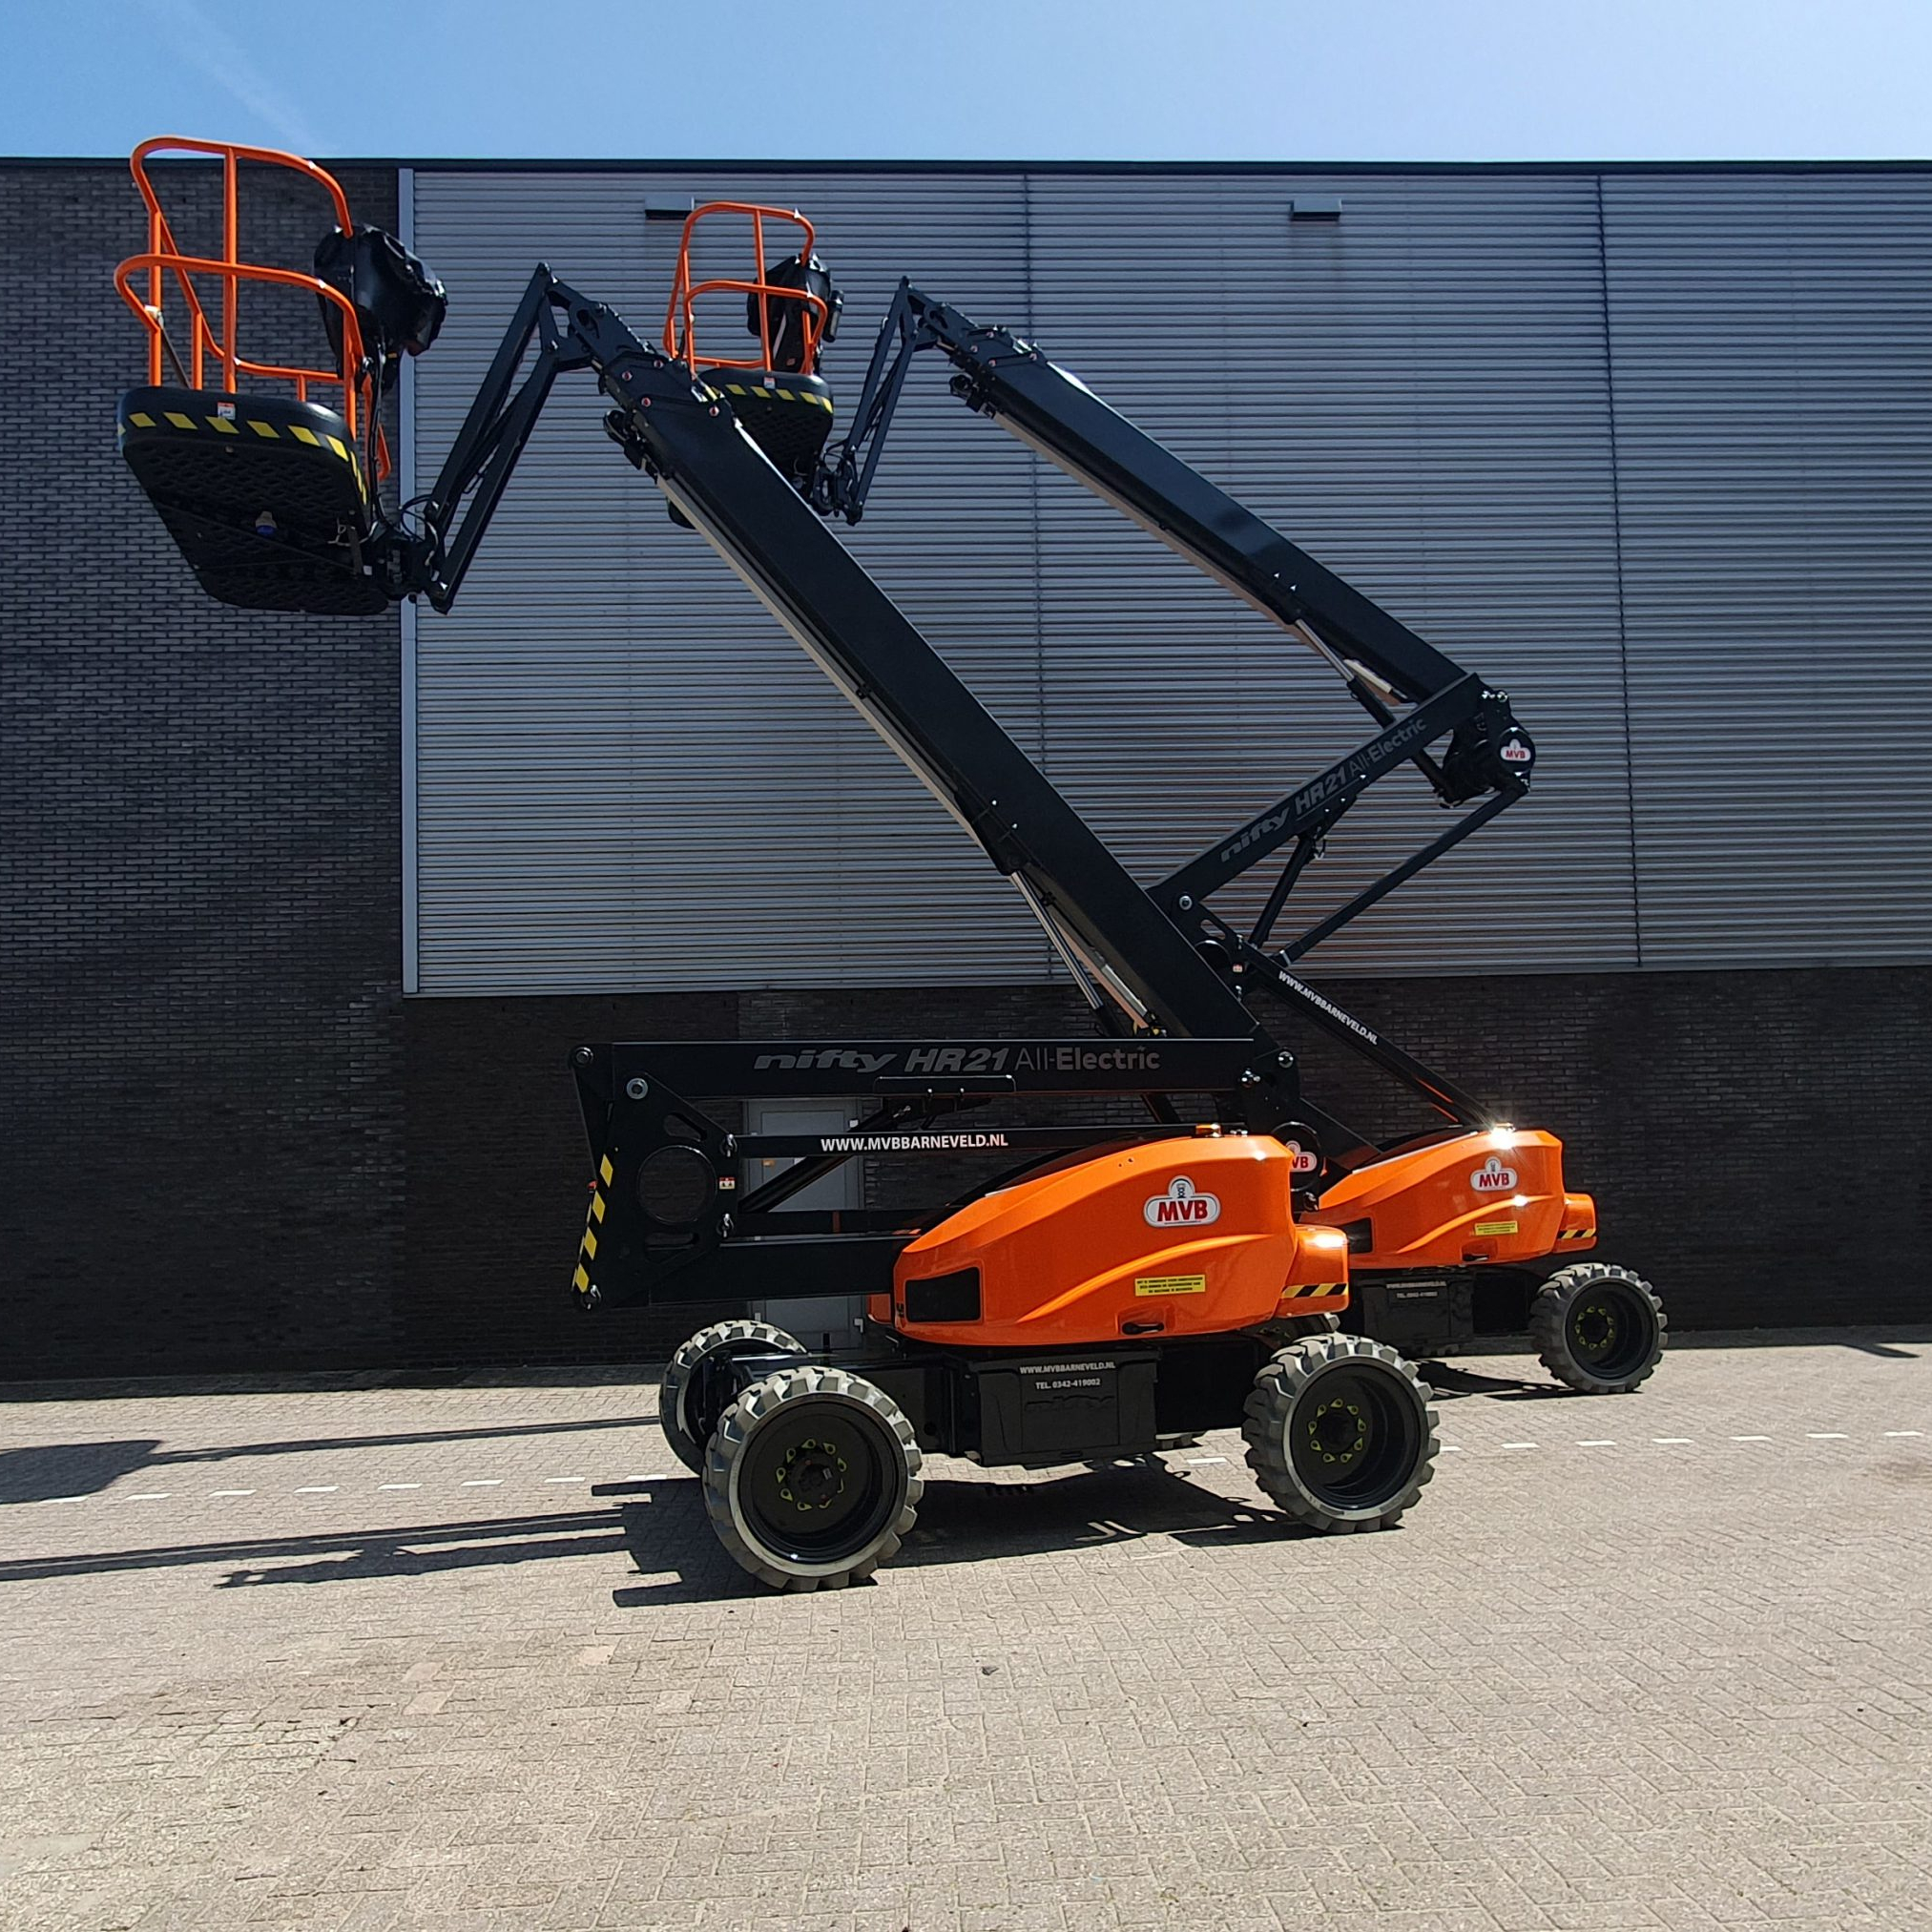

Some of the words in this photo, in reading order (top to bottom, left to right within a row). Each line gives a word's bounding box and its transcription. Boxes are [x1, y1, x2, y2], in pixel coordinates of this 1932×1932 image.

[1505, 750, 1527, 759] MVB
[1221, 807, 1290, 862] nifty
[1294, 765, 1347, 815] HR21
[1278, 970, 1379, 1046] WWW.MVBBARNEVELD.NL
[754, 1049, 897, 1073] nifty
[904, 1048, 1008, 1073] HR21
[821, 1133, 1008, 1153] WWW.MVBBARNEVELD.NL
[1479, 1172, 1510, 1188] MVB
[1157, 1199, 1209, 1222] MVB
[1019, 1361, 1116, 1375] WWW.MVBBARNEVELD.NL
